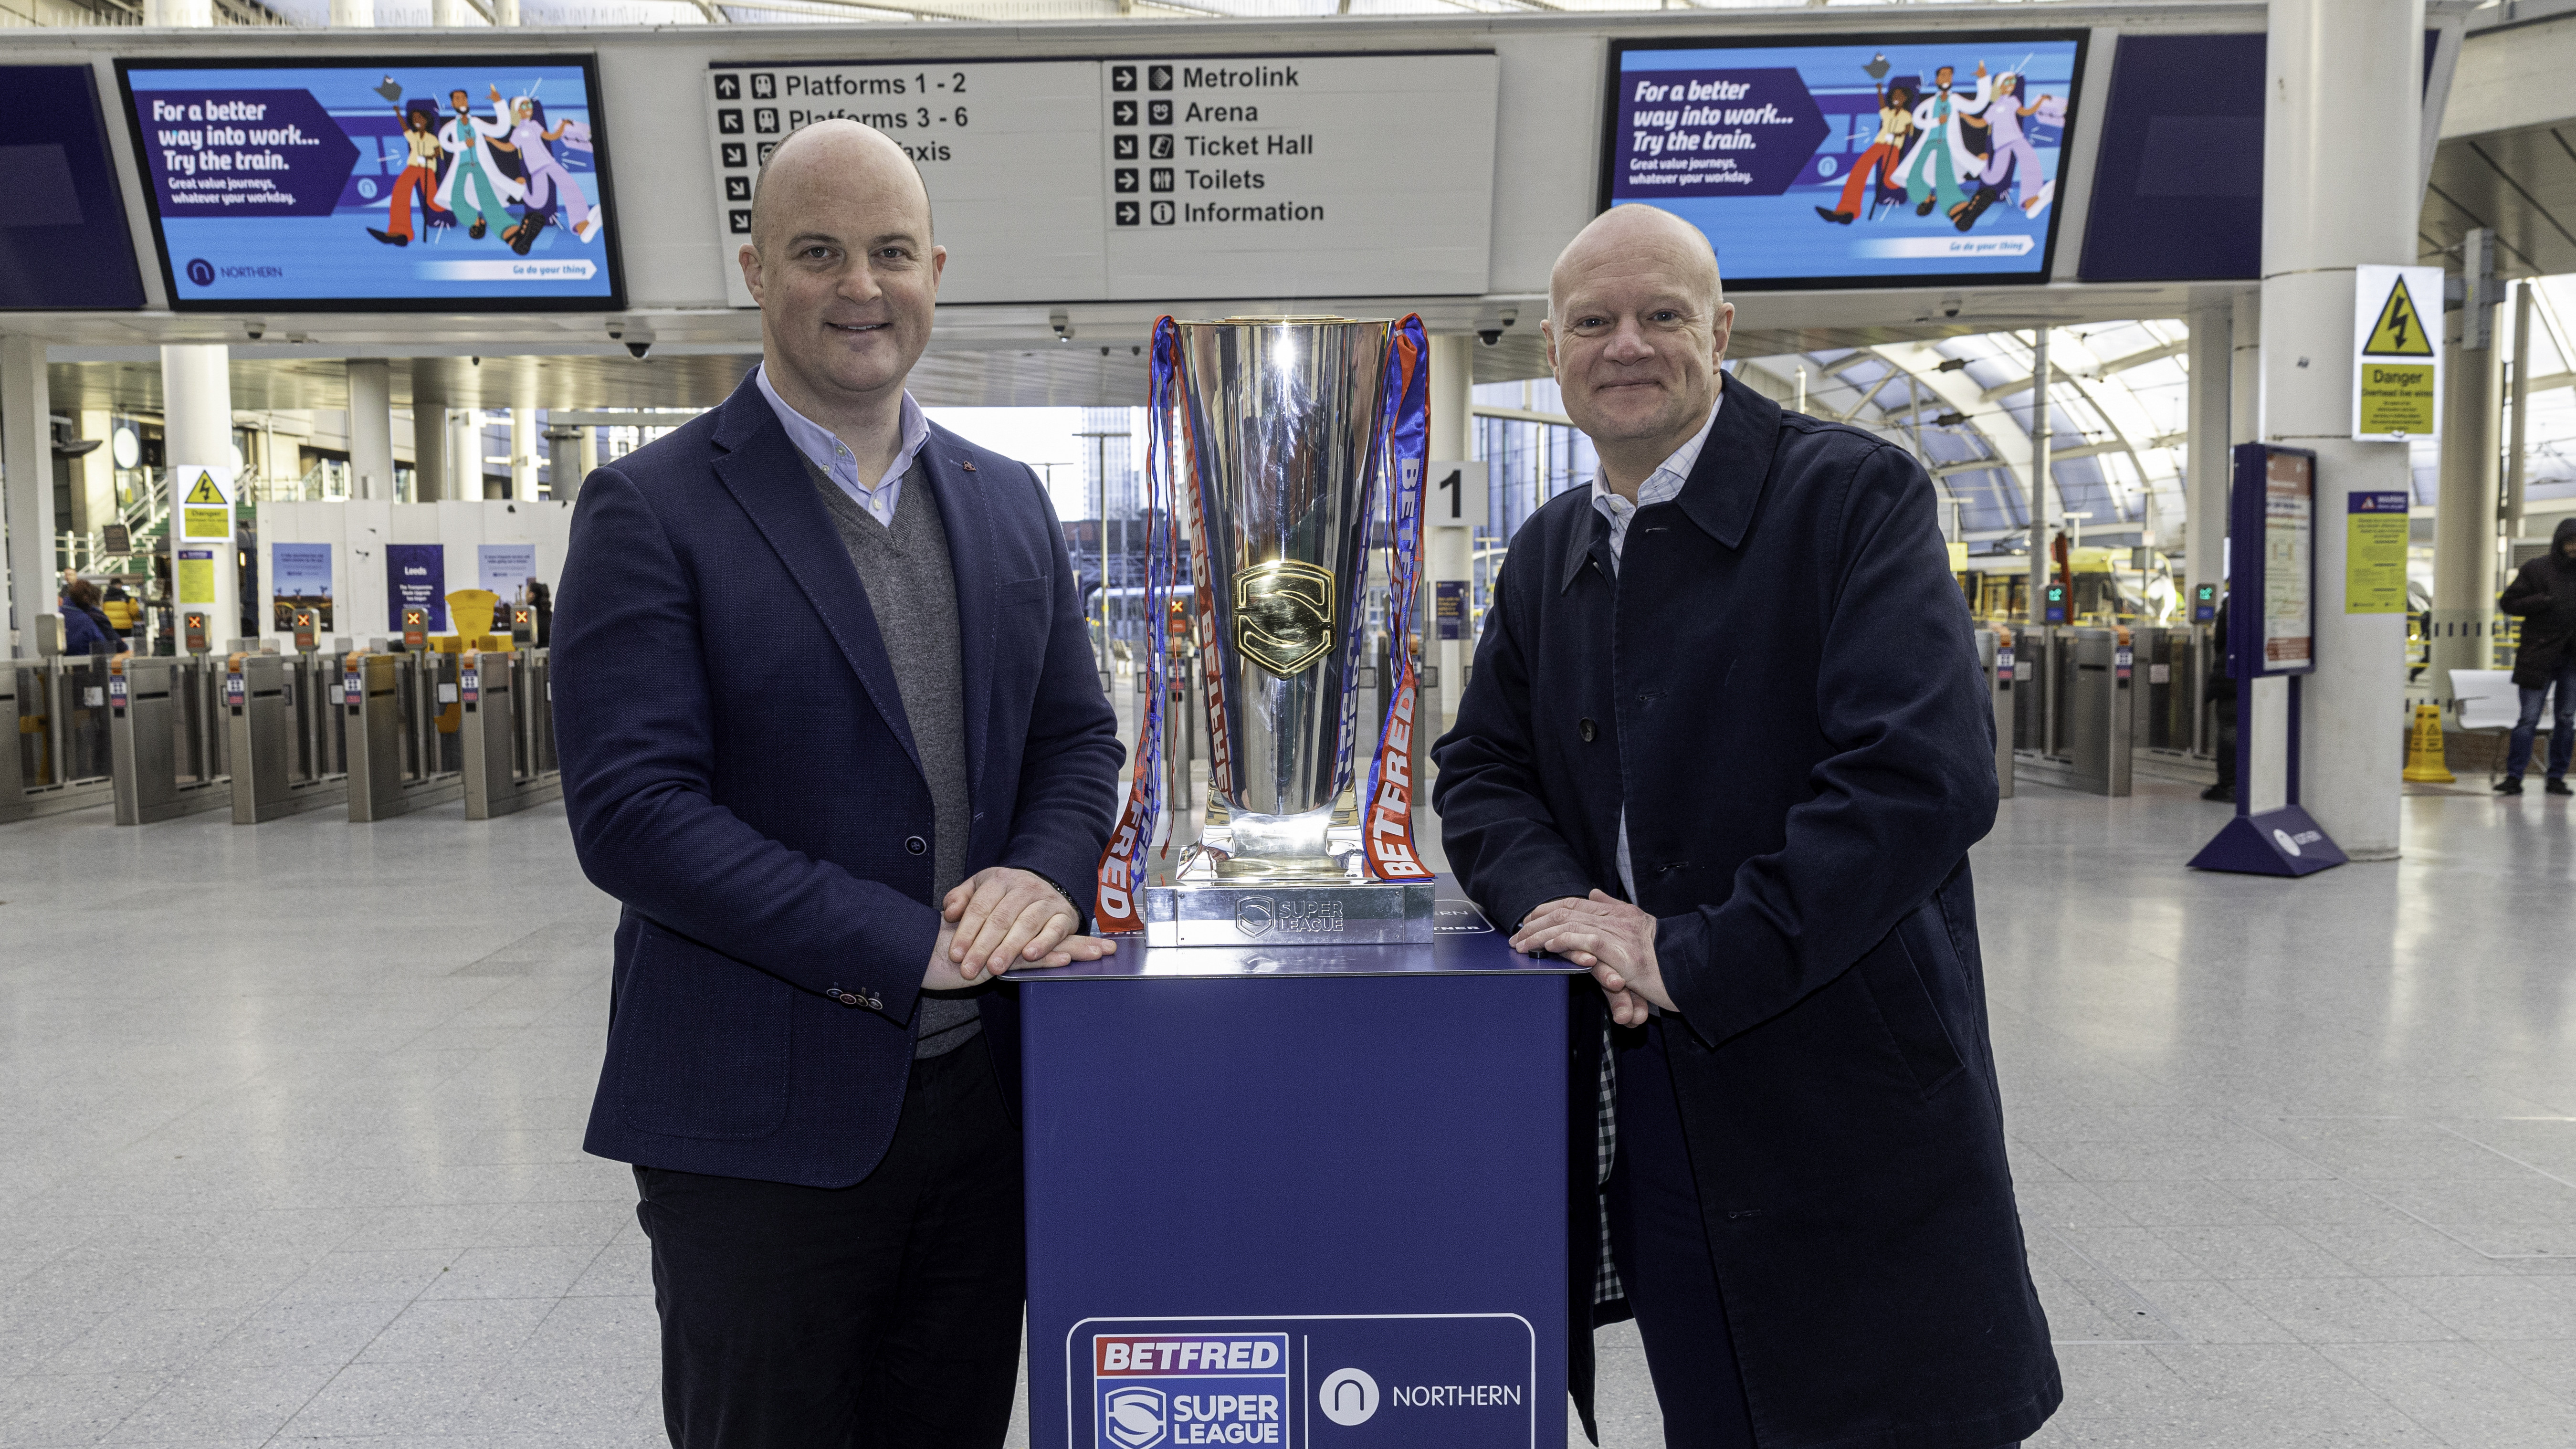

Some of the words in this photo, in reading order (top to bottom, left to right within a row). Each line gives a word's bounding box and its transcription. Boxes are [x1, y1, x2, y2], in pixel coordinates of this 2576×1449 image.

[786, 74, 906, 95] Platforms
[915, 73, 925, 93] 1
[953, 72, 966, 93] 2
[1184, 66, 1299, 87] Metrolink
[1634, 80, 1669, 102] For
[1670, 84, 1685, 102] a
[1687, 79, 1751, 101] better
[152, 99, 185, 121] For
[188, 104, 203, 121] a
[206, 99, 267, 121] better
[917, 107, 930, 128] 3
[955, 106, 968, 127] 6
[1185, 102, 1258, 122] Arena
[1633, 110, 1679, 131] way
[1680, 105, 1721, 126] into
[1724, 103, 1794, 126] work...
[158, 129, 203, 151] way
[207, 125, 246, 146] into
[249, 124, 320, 146] work...
[1185, 136, 1259, 156] Ticket
[1268, 134, 1313, 155] Hall
[1633, 130, 1665, 157] Try
[1666, 130, 1701, 151] the
[1703, 128, 1757, 150] train.
[898, 141, 951, 161] axis
[163, 150, 196, 176] Try
[199, 149, 232, 171] the
[235, 149, 290, 170] train.
[1630, 158, 1658, 170] Great
[1660, 158, 1689, 170] value
[168, 177, 198, 189] Great
[197, 177, 226, 189] value
[1185, 169, 1265, 190] Toilets
[1629, 172, 1678, 185] whatever
[1679, 173, 1704, 186] your
[1704, 170, 1753, 185] workday.
[171, 191, 220, 204] whatever
[221, 193, 245, 206] your
[246, 191, 296, 205] workday.
[1185, 200, 1324, 222] Information
[1976, 243, 1998, 252] your
[220, 265, 283, 278] NORTHERN
[526, 265, 537, 274] do
[540, 266, 560, 275] your
[563, 265, 586, 275] thing
[2373, 368, 2424, 387] Danger
[1440, 469, 1461, 518] 1
[1373, 687, 1425, 876] BETFRED
[1279, 901, 1344, 919] SUPER
[1279, 917, 1344, 933] LEAGUE
[1104, 1341, 1279, 1370] BETFRED
[1393, 1385, 1521, 1407] NORTHERN
[1173, 1395, 1279, 1422] SUPER
[1174, 1423, 1279, 1444] LEAGUE
